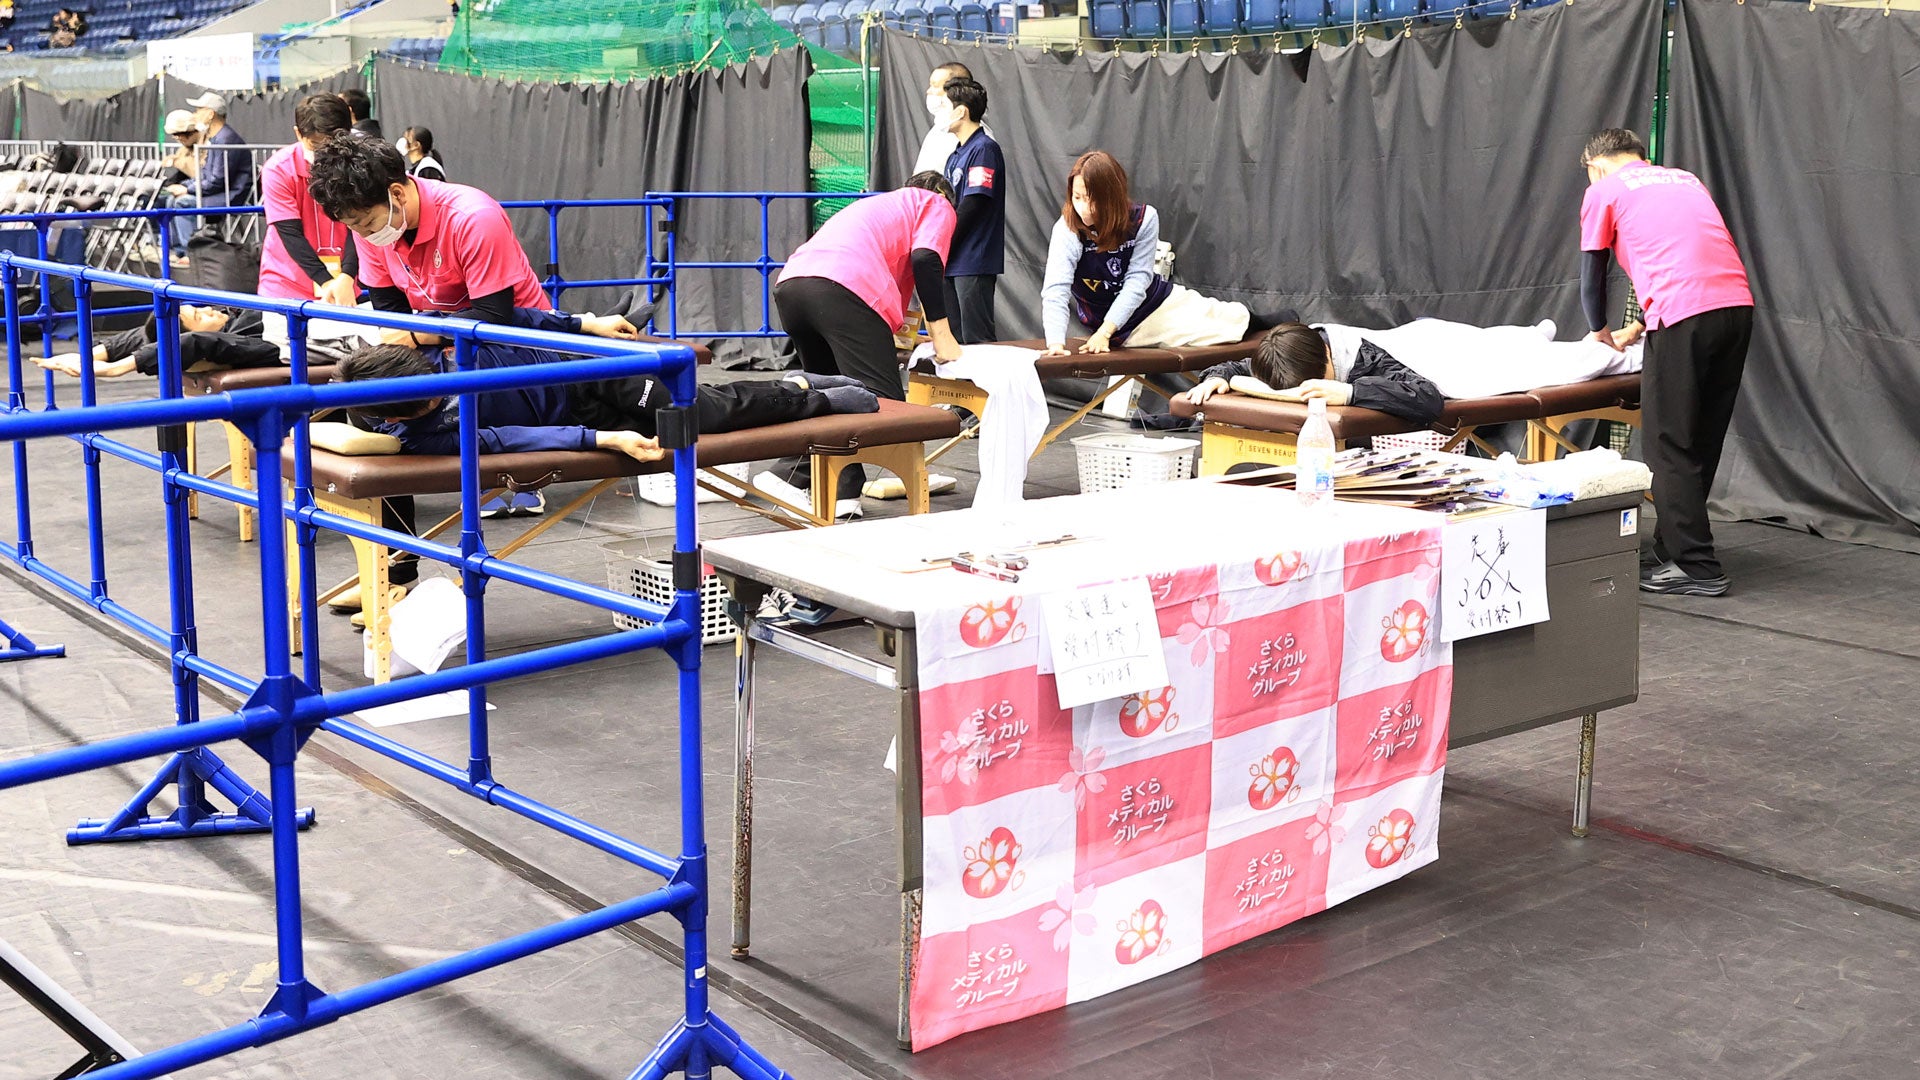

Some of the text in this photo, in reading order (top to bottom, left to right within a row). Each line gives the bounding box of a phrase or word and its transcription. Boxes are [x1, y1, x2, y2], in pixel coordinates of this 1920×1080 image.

[1248, 445, 1271, 454] SEVEN
[1274, 448, 1297, 458] BEAUT
[1260, 632, 1295, 656] さくら
[1247, 649, 1307, 680] メディカル
[1252, 667, 1301, 698] グループ
[971, 700, 1014, 726] さくら
[1380, 700, 1412, 722] さくら
[1367, 713, 1422, 745] メディカル
[965, 738, 1022, 771] グループ
[1372, 731, 1418, 762] グループ
[1121, 777, 1161, 802] さくら
[1107, 794, 1174, 828] メディカル
[1113, 813, 1168, 845] グループ
[1247, 848, 1284, 873] さくら
[1233, 864, 1295, 897] メディカル
[1238, 881, 1289, 913] グループ
[968, 943, 1013, 968] さくら
[950, 959, 1027, 991] メディカル
[956, 976, 1019, 1009] グループ
